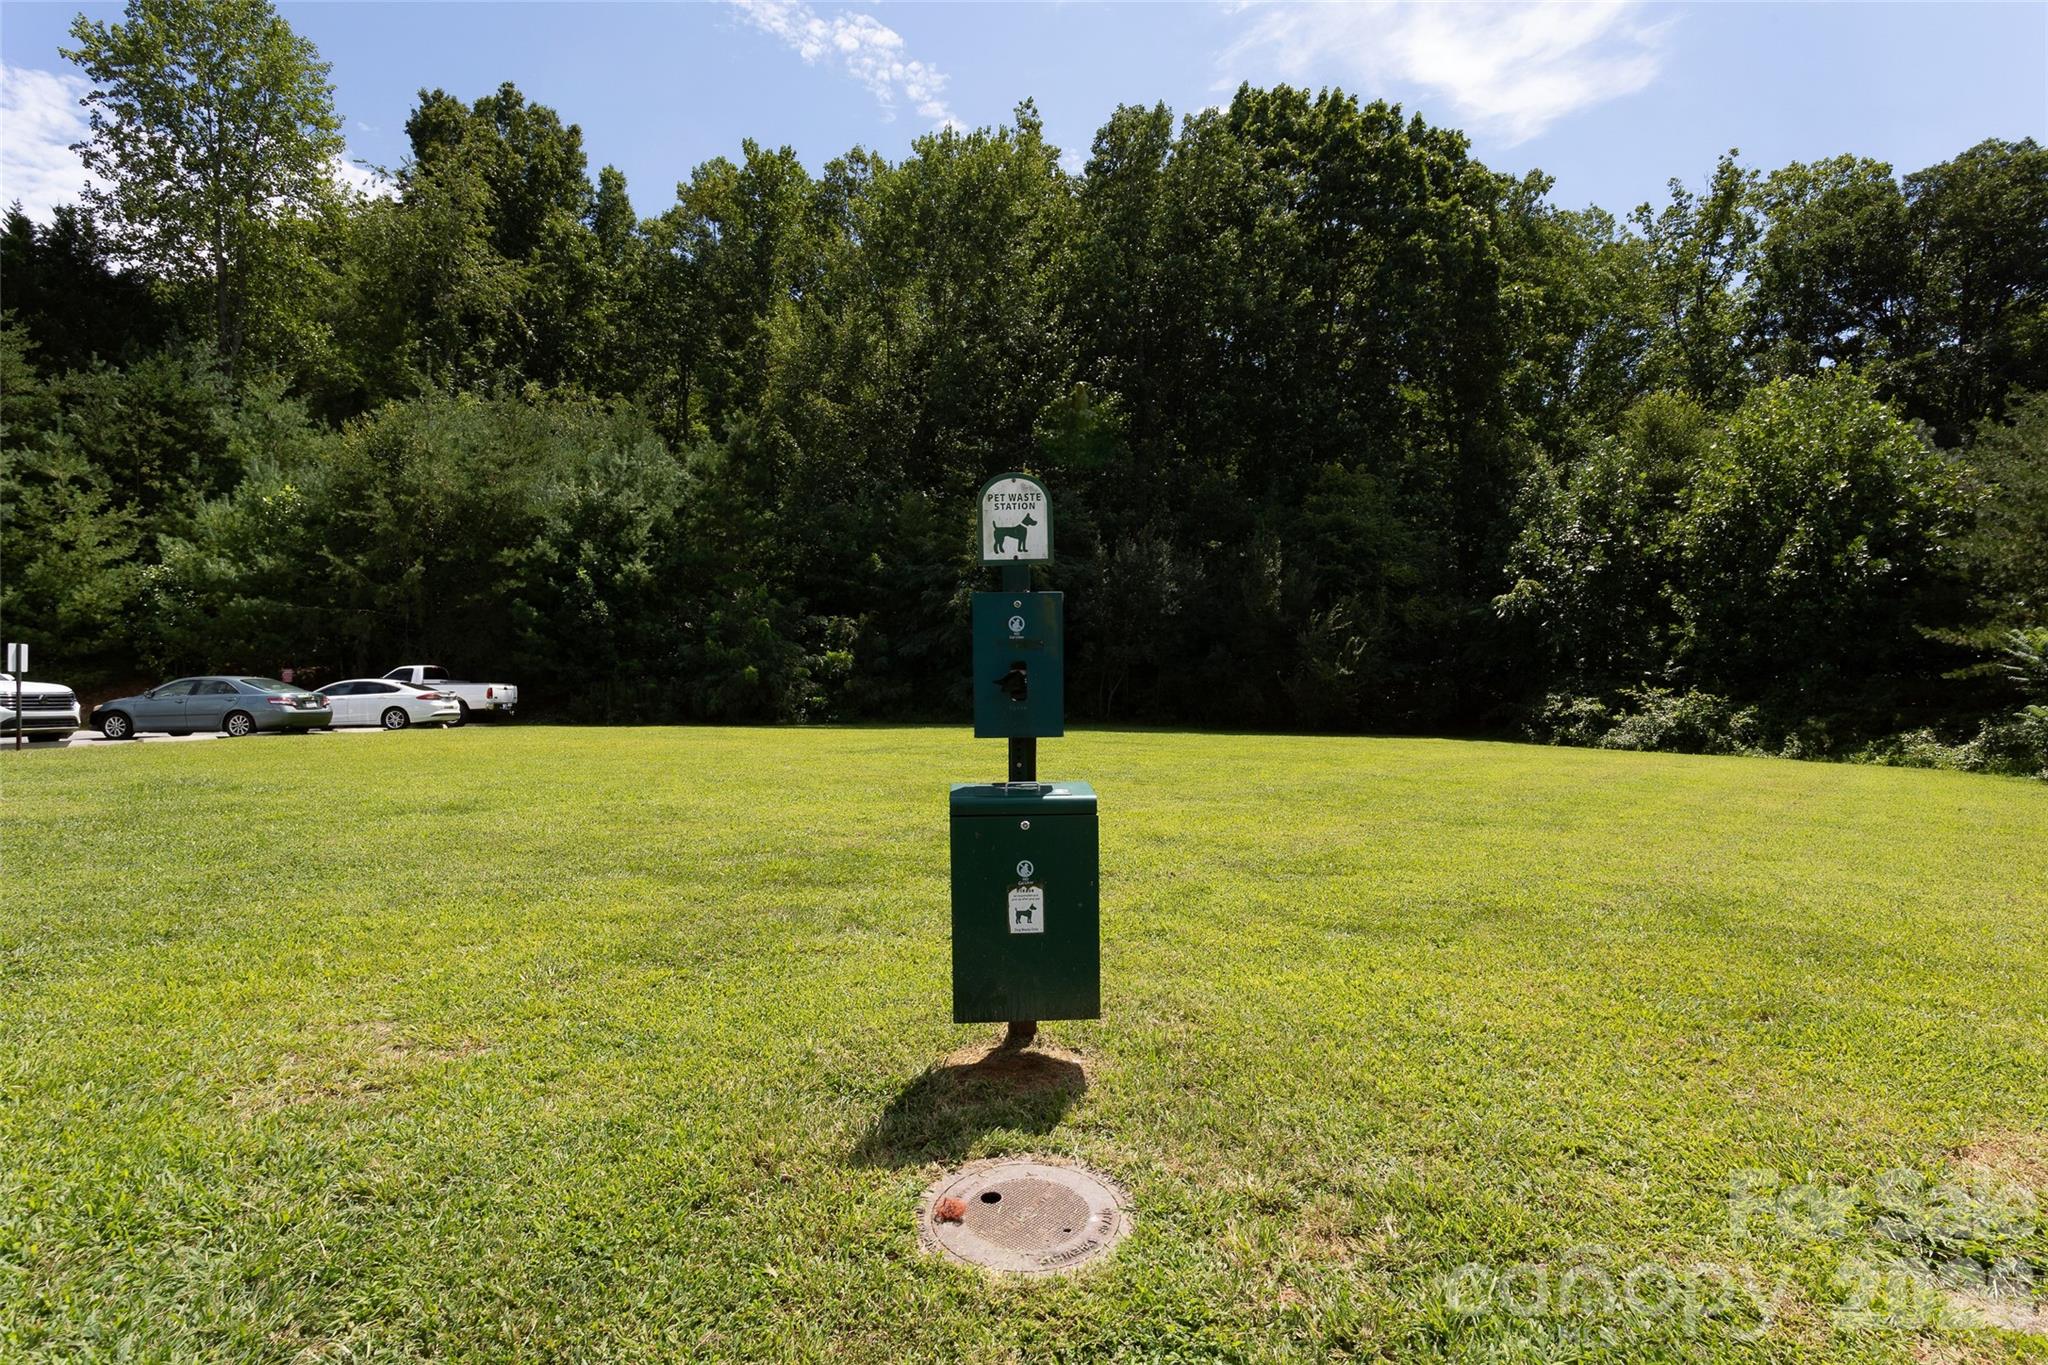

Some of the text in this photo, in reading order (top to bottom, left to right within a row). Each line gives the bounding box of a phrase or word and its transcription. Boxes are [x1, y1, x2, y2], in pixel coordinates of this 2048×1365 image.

[987, 492, 1042, 503] PET WASTE
[994, 502, 1036, 511] STATION
